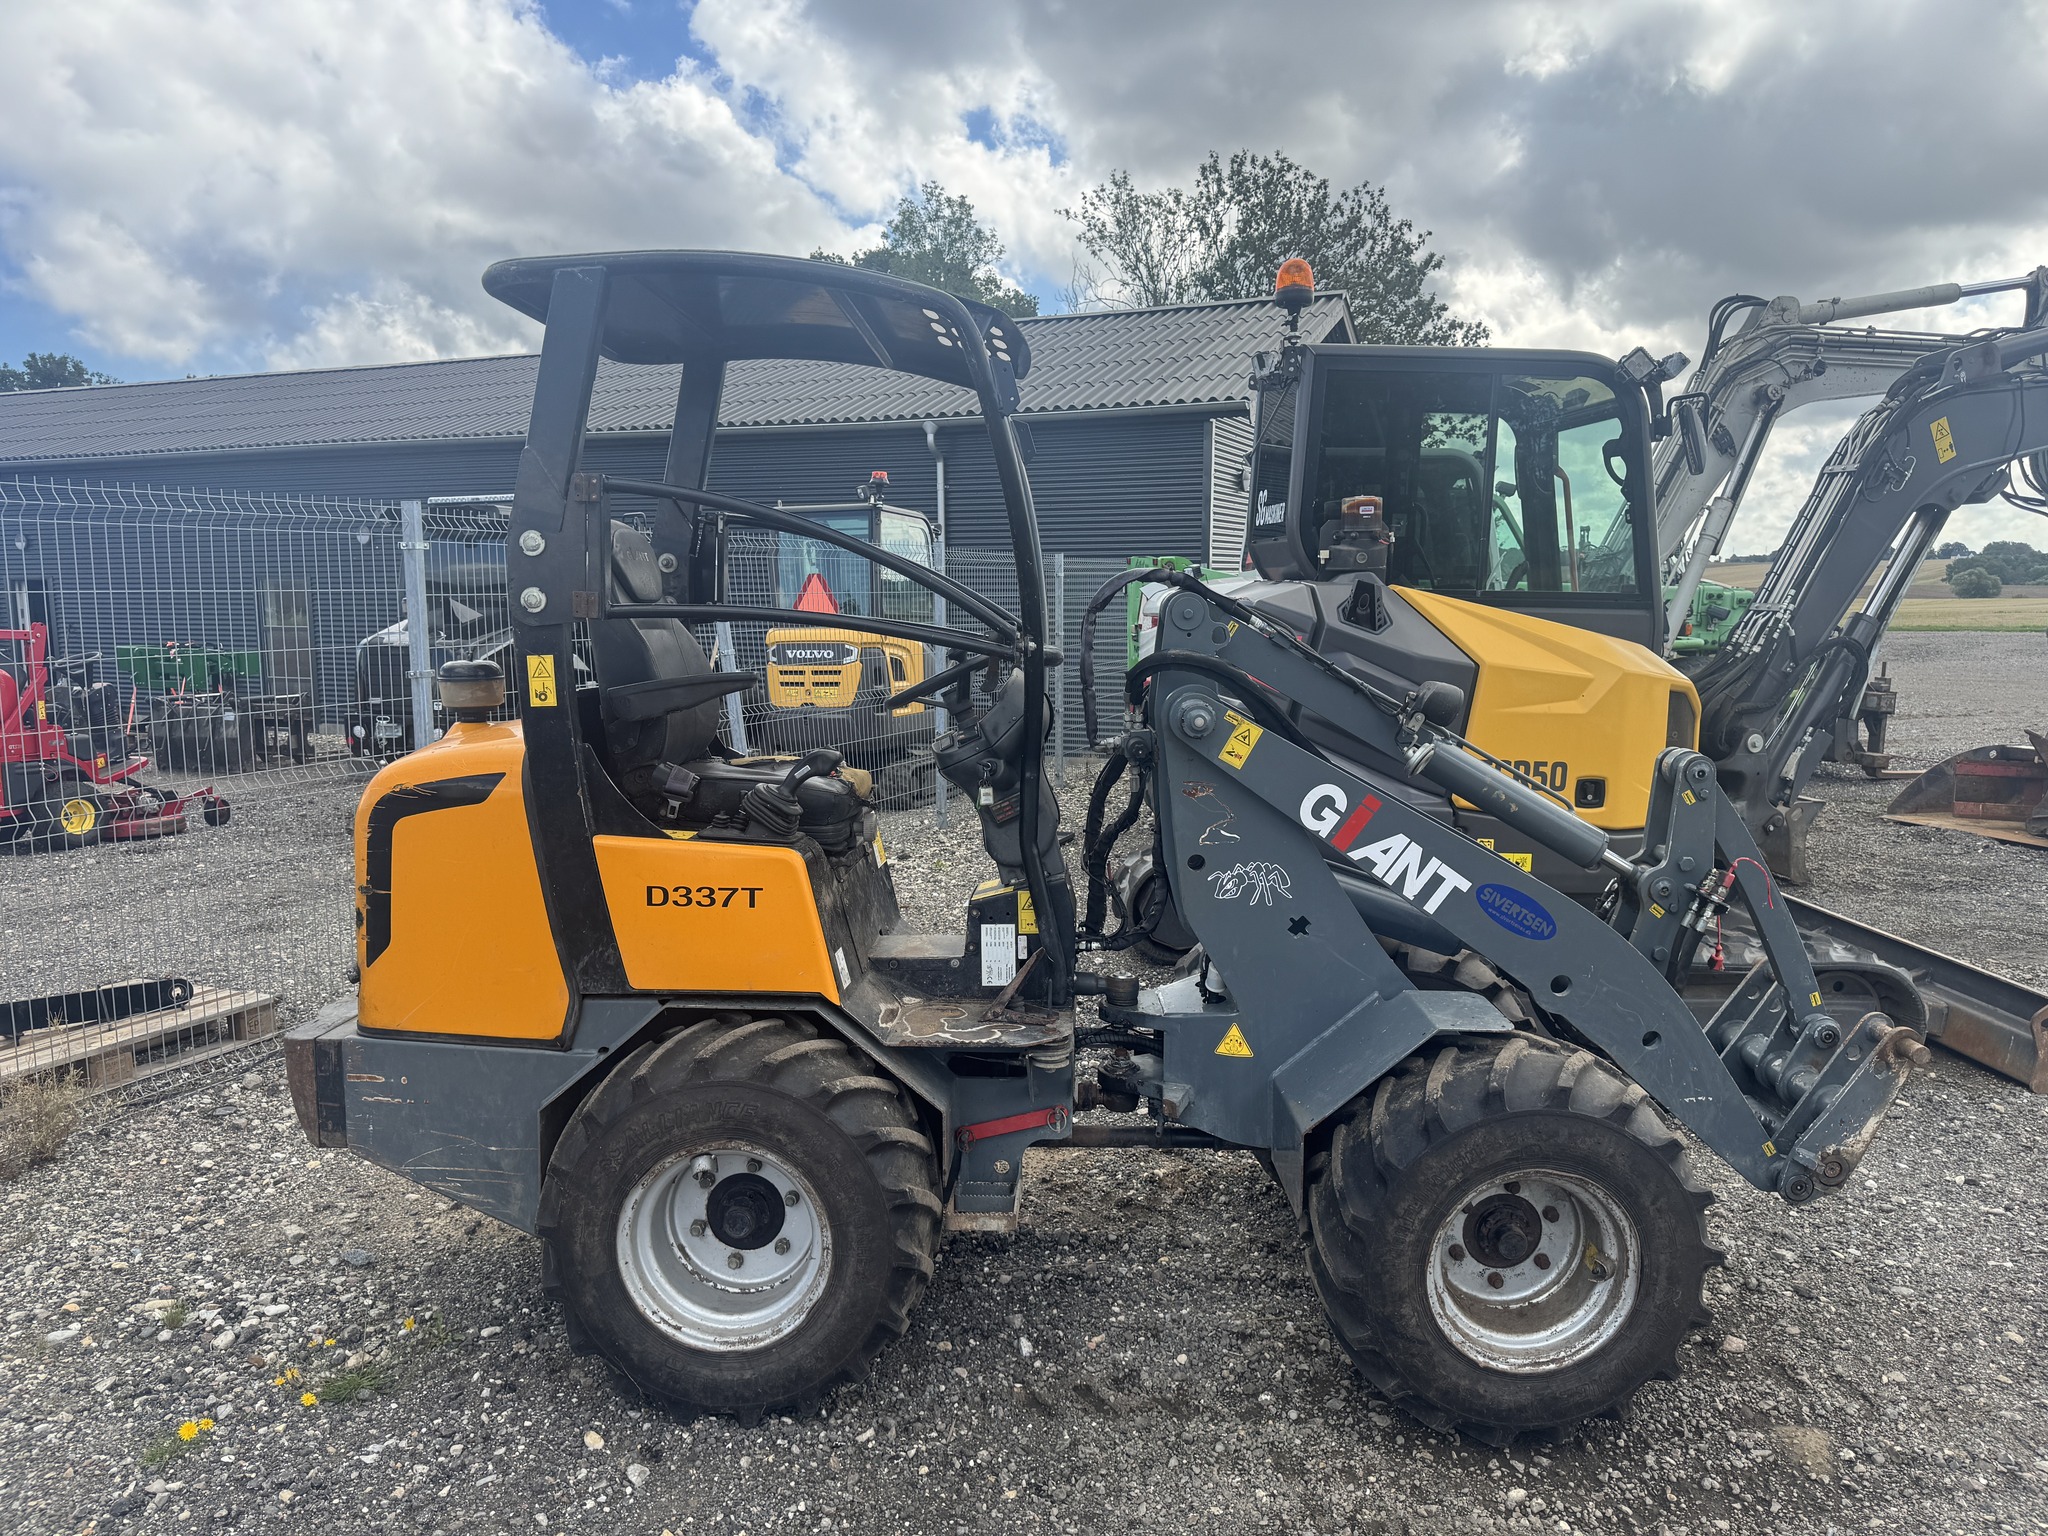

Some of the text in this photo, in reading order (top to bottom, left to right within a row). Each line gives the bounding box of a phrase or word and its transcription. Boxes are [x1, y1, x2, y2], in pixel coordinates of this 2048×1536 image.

[785, 649, 834, 658] VOLVO
[646, 885, 764, 909] D337T
[1480, 887, 1553, 937] SIVERTSEN
[623, 1101, 760, 1150] ALLIANCE
